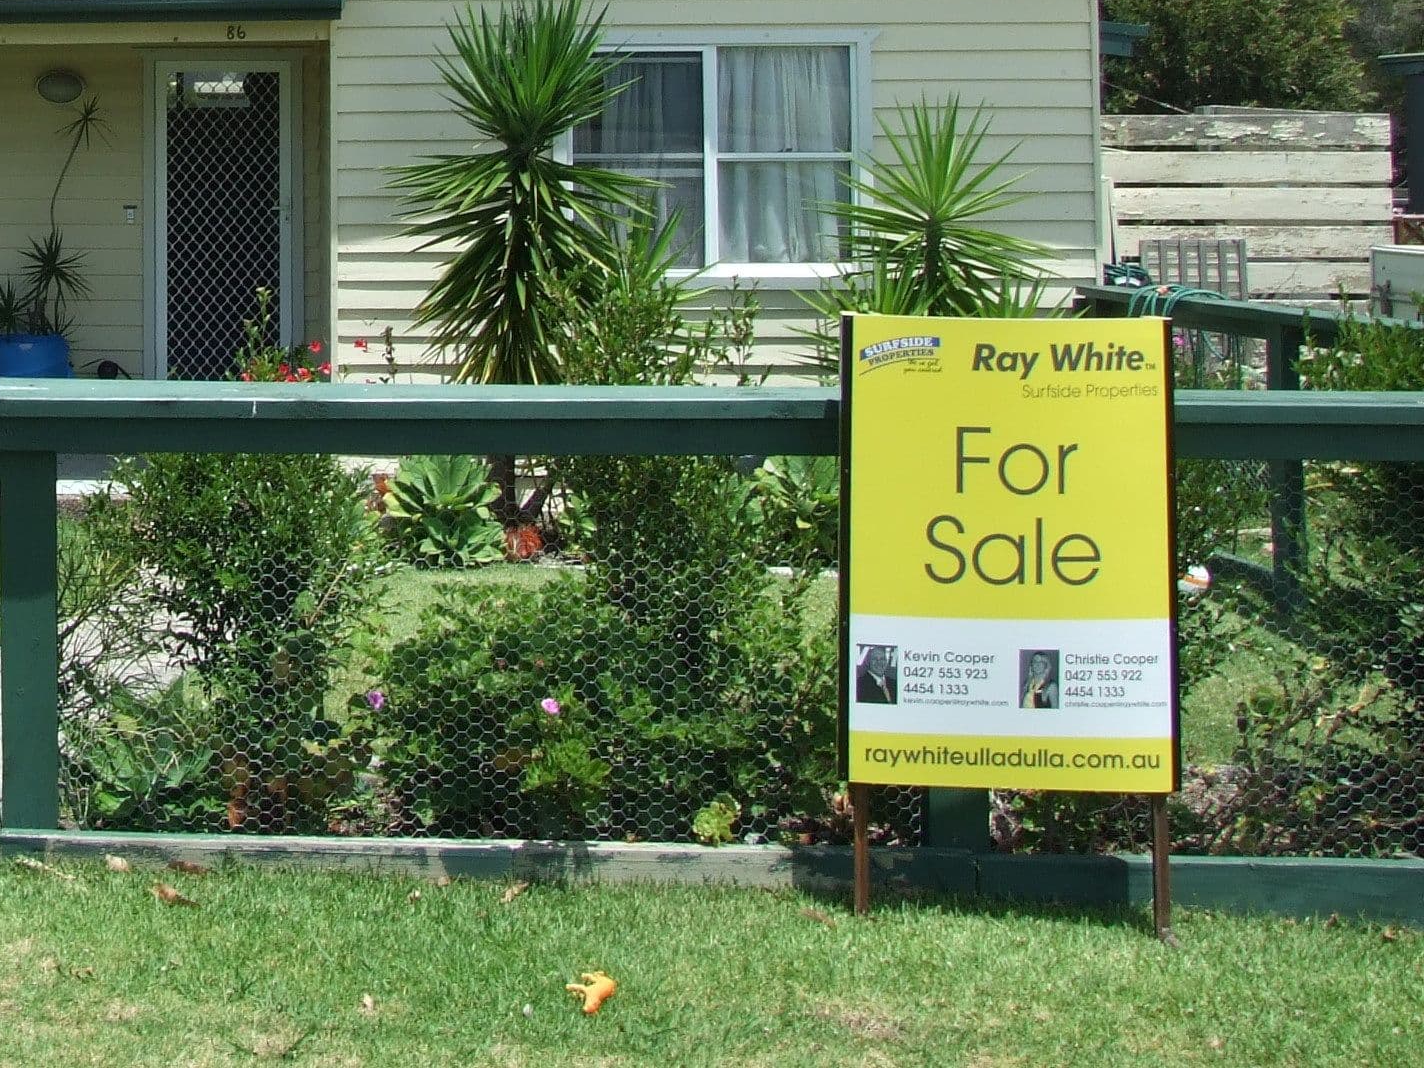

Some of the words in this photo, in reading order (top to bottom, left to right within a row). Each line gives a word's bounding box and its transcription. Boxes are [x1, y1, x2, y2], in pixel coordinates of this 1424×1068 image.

[226, 25, 246, 40] 86
[864, 337, 933, 357] SURFSIDE
[868, 349, 934, 366] PROPERTIES
[972, 343, 1039, 380] Ray
[1050, 342, 1144, 372] White
[1022, 384, 1081, 399] Surfside
[1086, 384, 1157, 400] Properties
[956, 426, 1078, 496] For
[924, 514, 1101, 586] Sale
[903, 650, 940, 662] Kevin
[944, 652, 995, 665] Cooper
[1065, 653, 1109, 665] Christie
[1113, 654, 1159, 668] Cooper
[903, 666, 934, 678] 0427
[938, 667, 961, 679] 553
[965, 668, 988, 679] 923
[1065, 670, 1093, 681] 0427
[1097, 670, 1118, 681] 553
[1121, 670, 1142, 681] 922
[903, 683, 934, 694] 4454
[939, 684, 969, 695] 1333
[1065, 686, 1093, 697] 4454
[1098, 686, 1125, 697] 1333
[865, 746, 1160, 769] raywhiteulladulla.com.au
